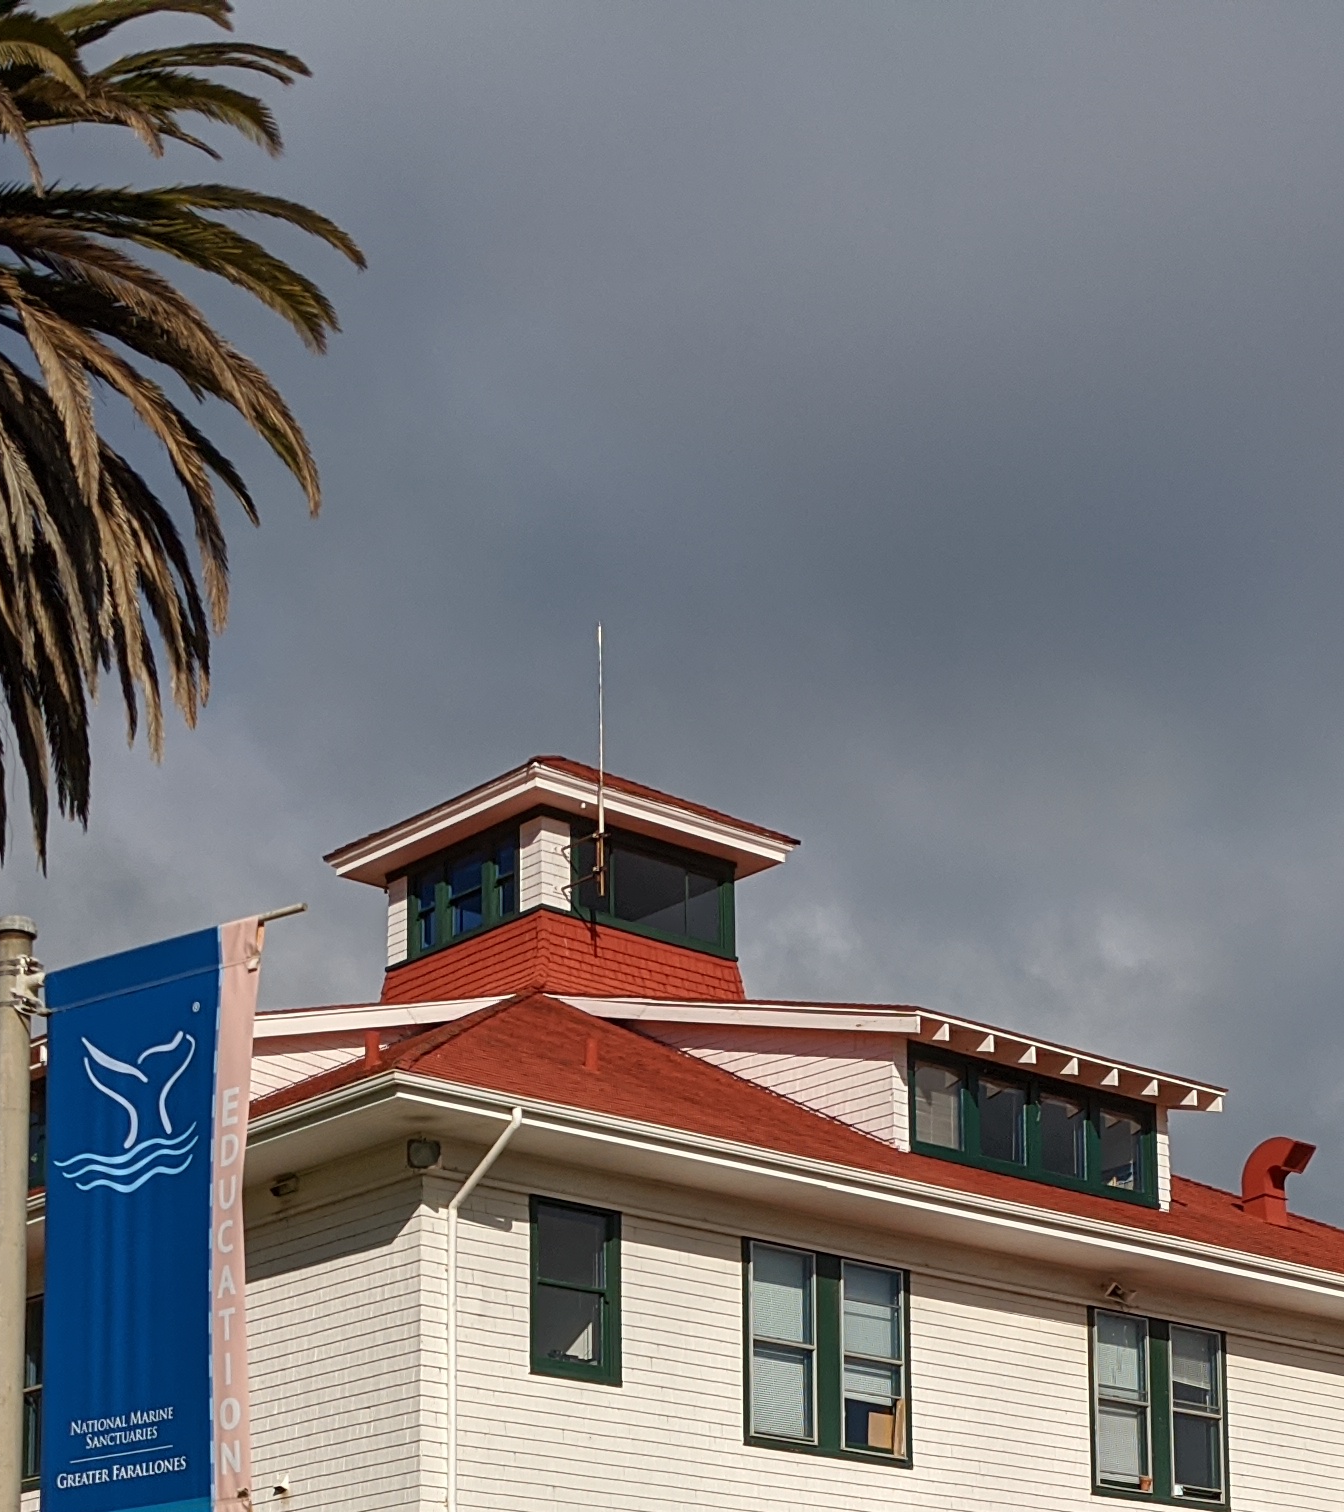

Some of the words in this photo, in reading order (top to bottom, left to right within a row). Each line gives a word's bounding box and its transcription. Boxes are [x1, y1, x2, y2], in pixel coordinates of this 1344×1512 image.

[216, 1086, 241, 1476] EDUCATION
[70, 1415, 127, 1436] NATIONAL
[130, 1406, 173, 1426] MARINE
[85, 1426, 158, 1449] SANCTUARIES
[56, 1469, 110, 1489] GREATER
[112, 1456, 187, 1481] FARALLONES
